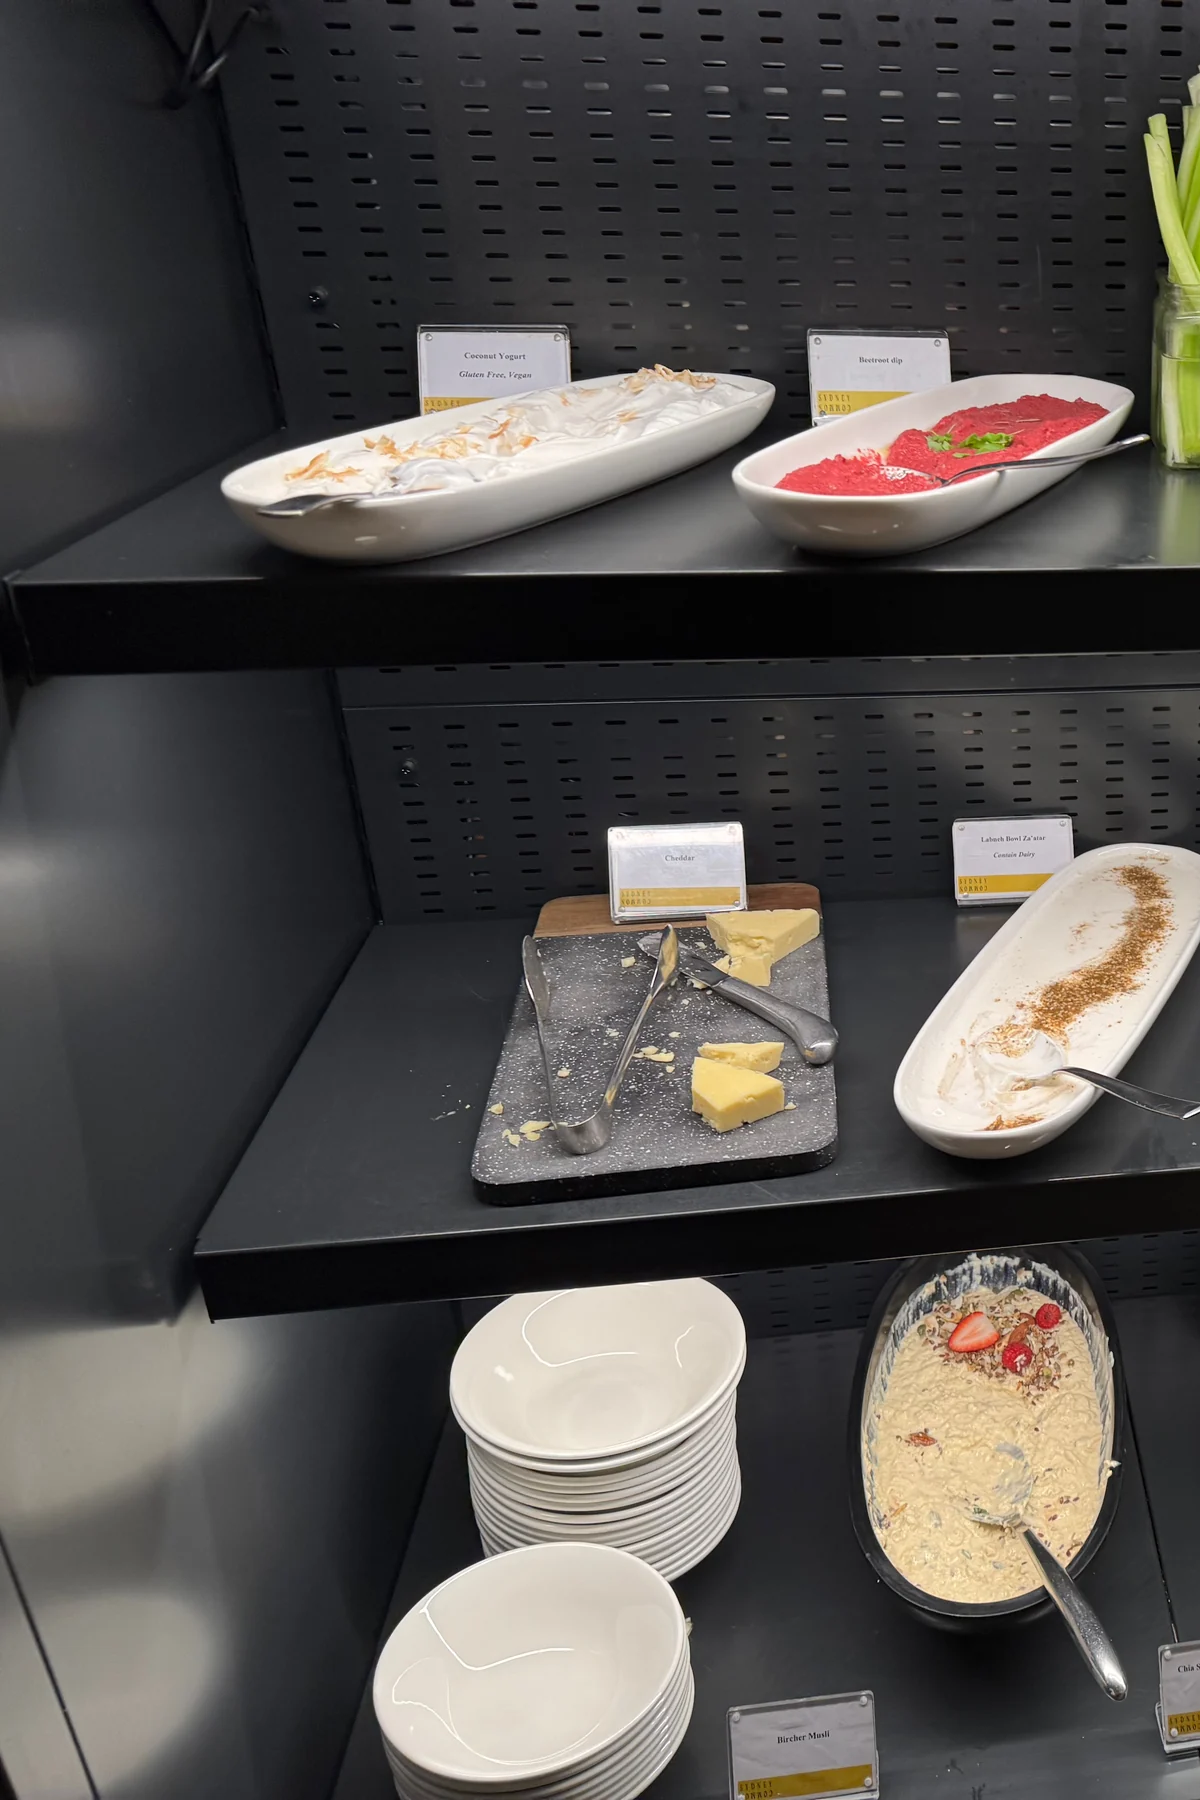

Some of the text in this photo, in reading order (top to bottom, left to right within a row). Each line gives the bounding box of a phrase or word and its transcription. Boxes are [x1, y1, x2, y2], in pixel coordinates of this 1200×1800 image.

[464, 352, 526, 361] Coconut Yogurt
[891, 357, 903, 365] dip
[459, 370, 532, 380] Gluten Free, Vegan
[1018, 851, 1035, 859] Dairy
[1177, 1664, 1195, 1673] Chia
[777, 1730, 830, 1744] Bircher Musli
